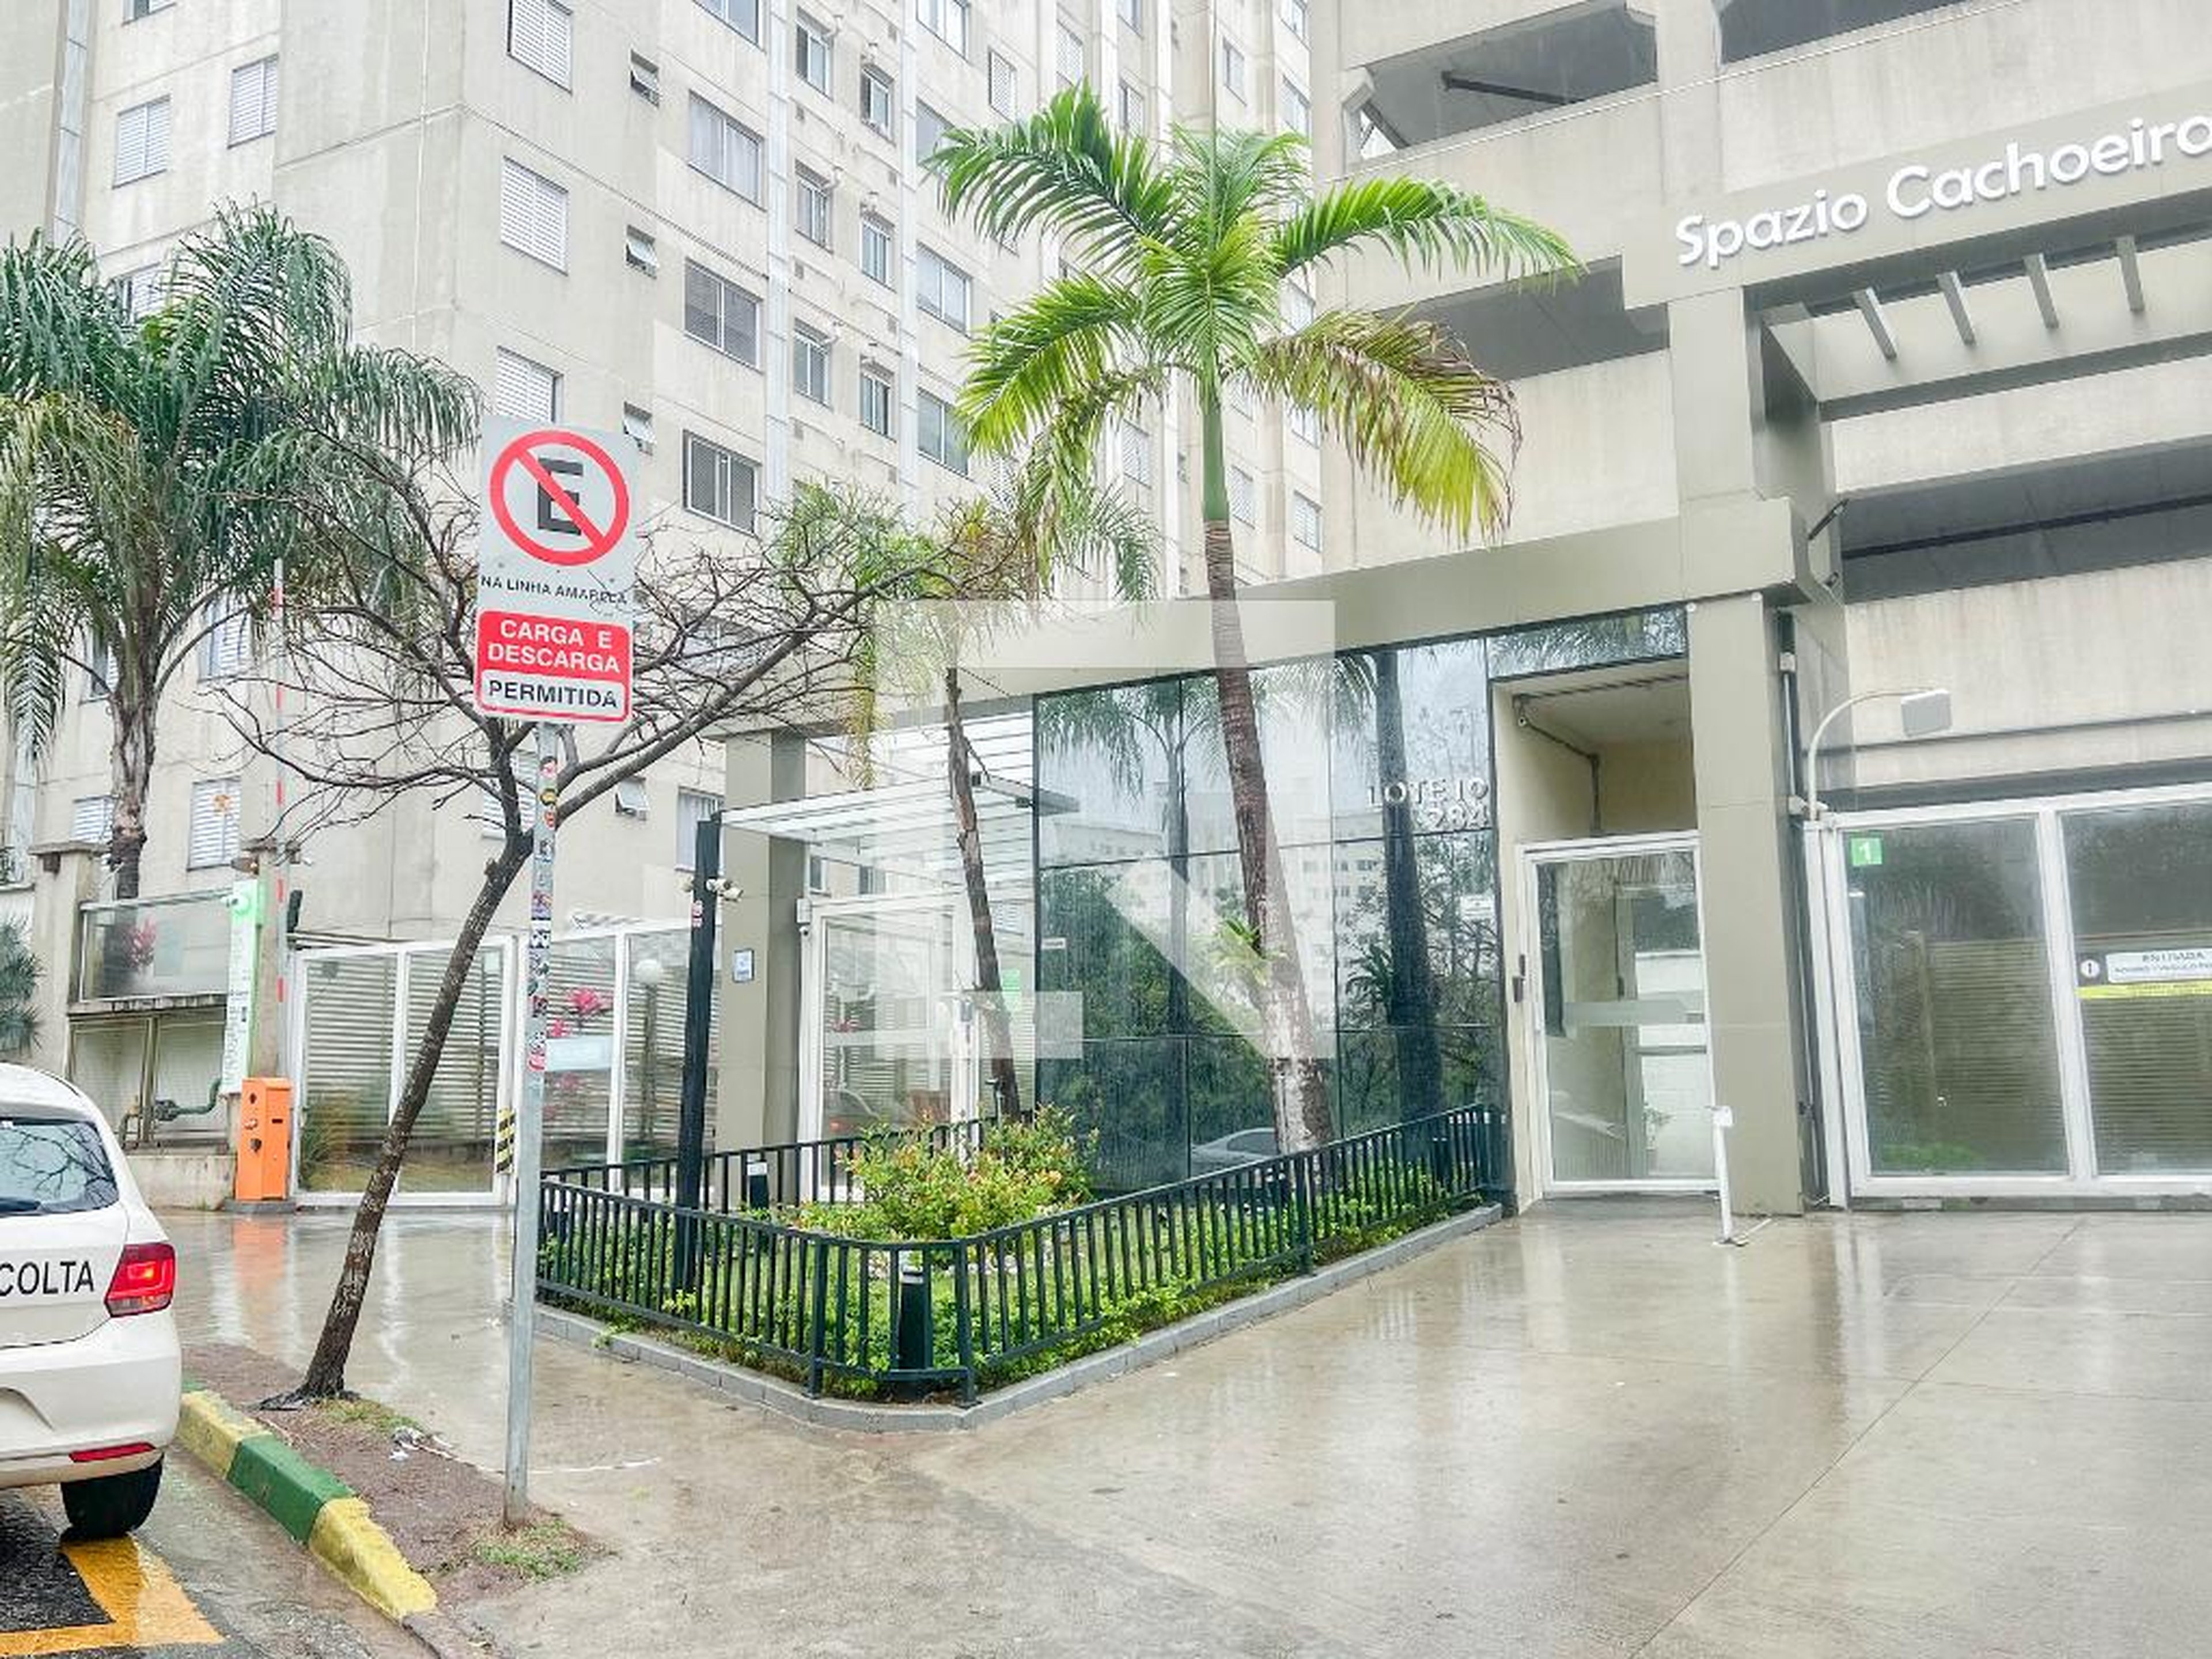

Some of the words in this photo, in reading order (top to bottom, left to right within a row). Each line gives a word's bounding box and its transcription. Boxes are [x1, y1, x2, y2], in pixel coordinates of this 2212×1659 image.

[1675, 189, 1868, 270] Spazio
[1887, 115, 2212, 219] Cachoeiro
[537, 457, 584, 536] E
[481, 575, 502, 589] NA
[506, 578, 551, 595] LINHA
[500, 619, 584, 646] CARGA
[598, 630, 612, 649] E
[487, 642, 620, 673] DESCARGA
[489, 680, 618, 709] PERMITIDA
[0, 1260, 95, 1297] COLTA
